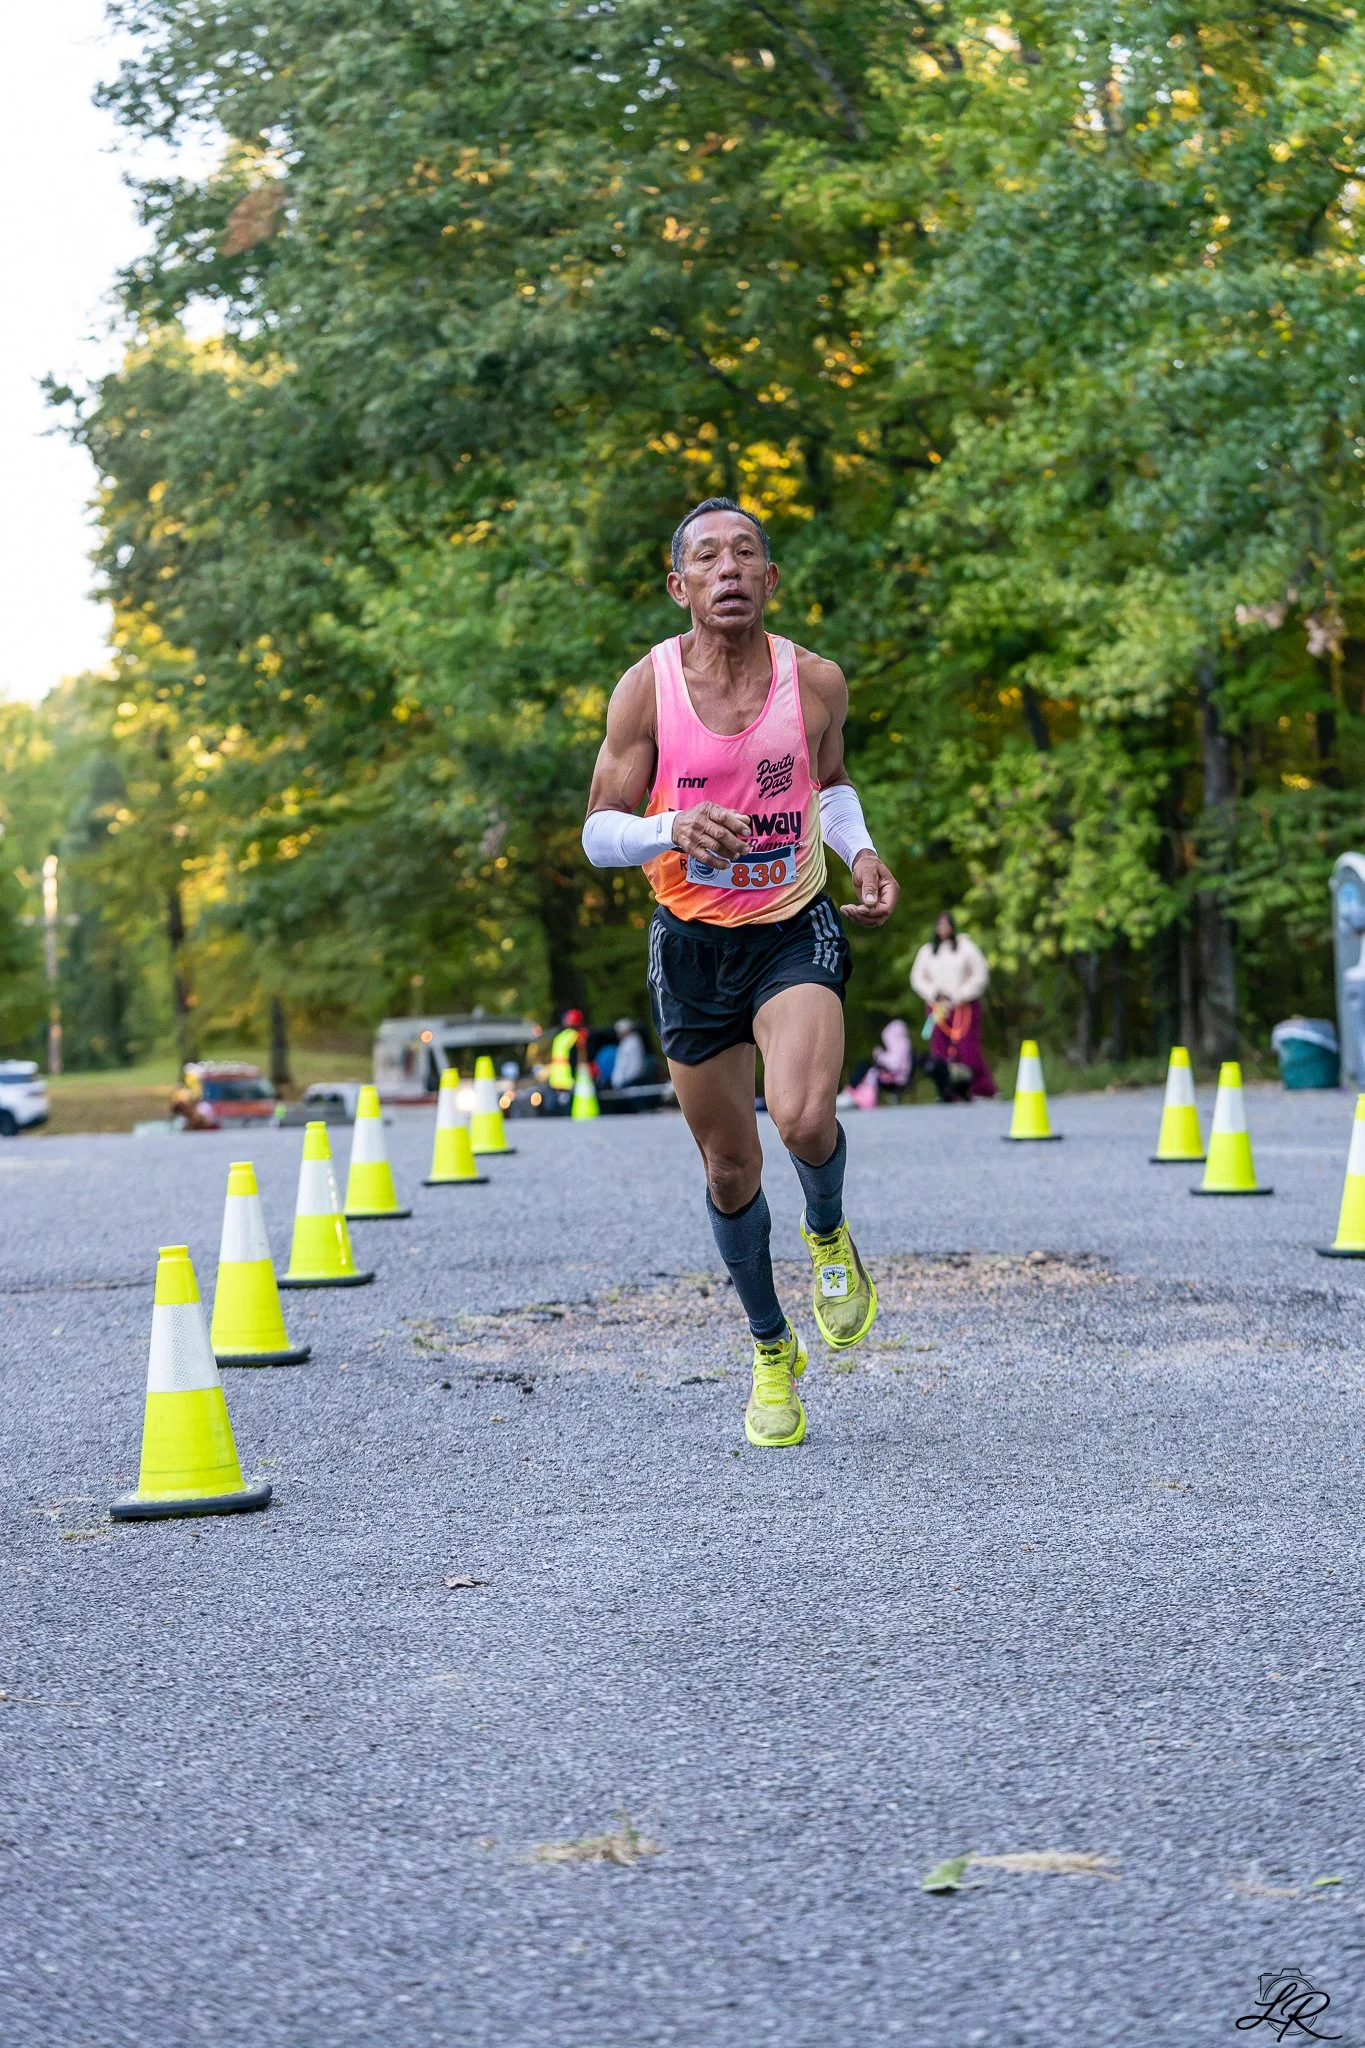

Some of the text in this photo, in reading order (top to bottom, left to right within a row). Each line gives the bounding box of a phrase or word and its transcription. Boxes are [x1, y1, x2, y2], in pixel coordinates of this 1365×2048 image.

[756, 753, 795, 783] Party
[758, 773, 793, 799] Pace
[731, 859, 786, 888] 830
